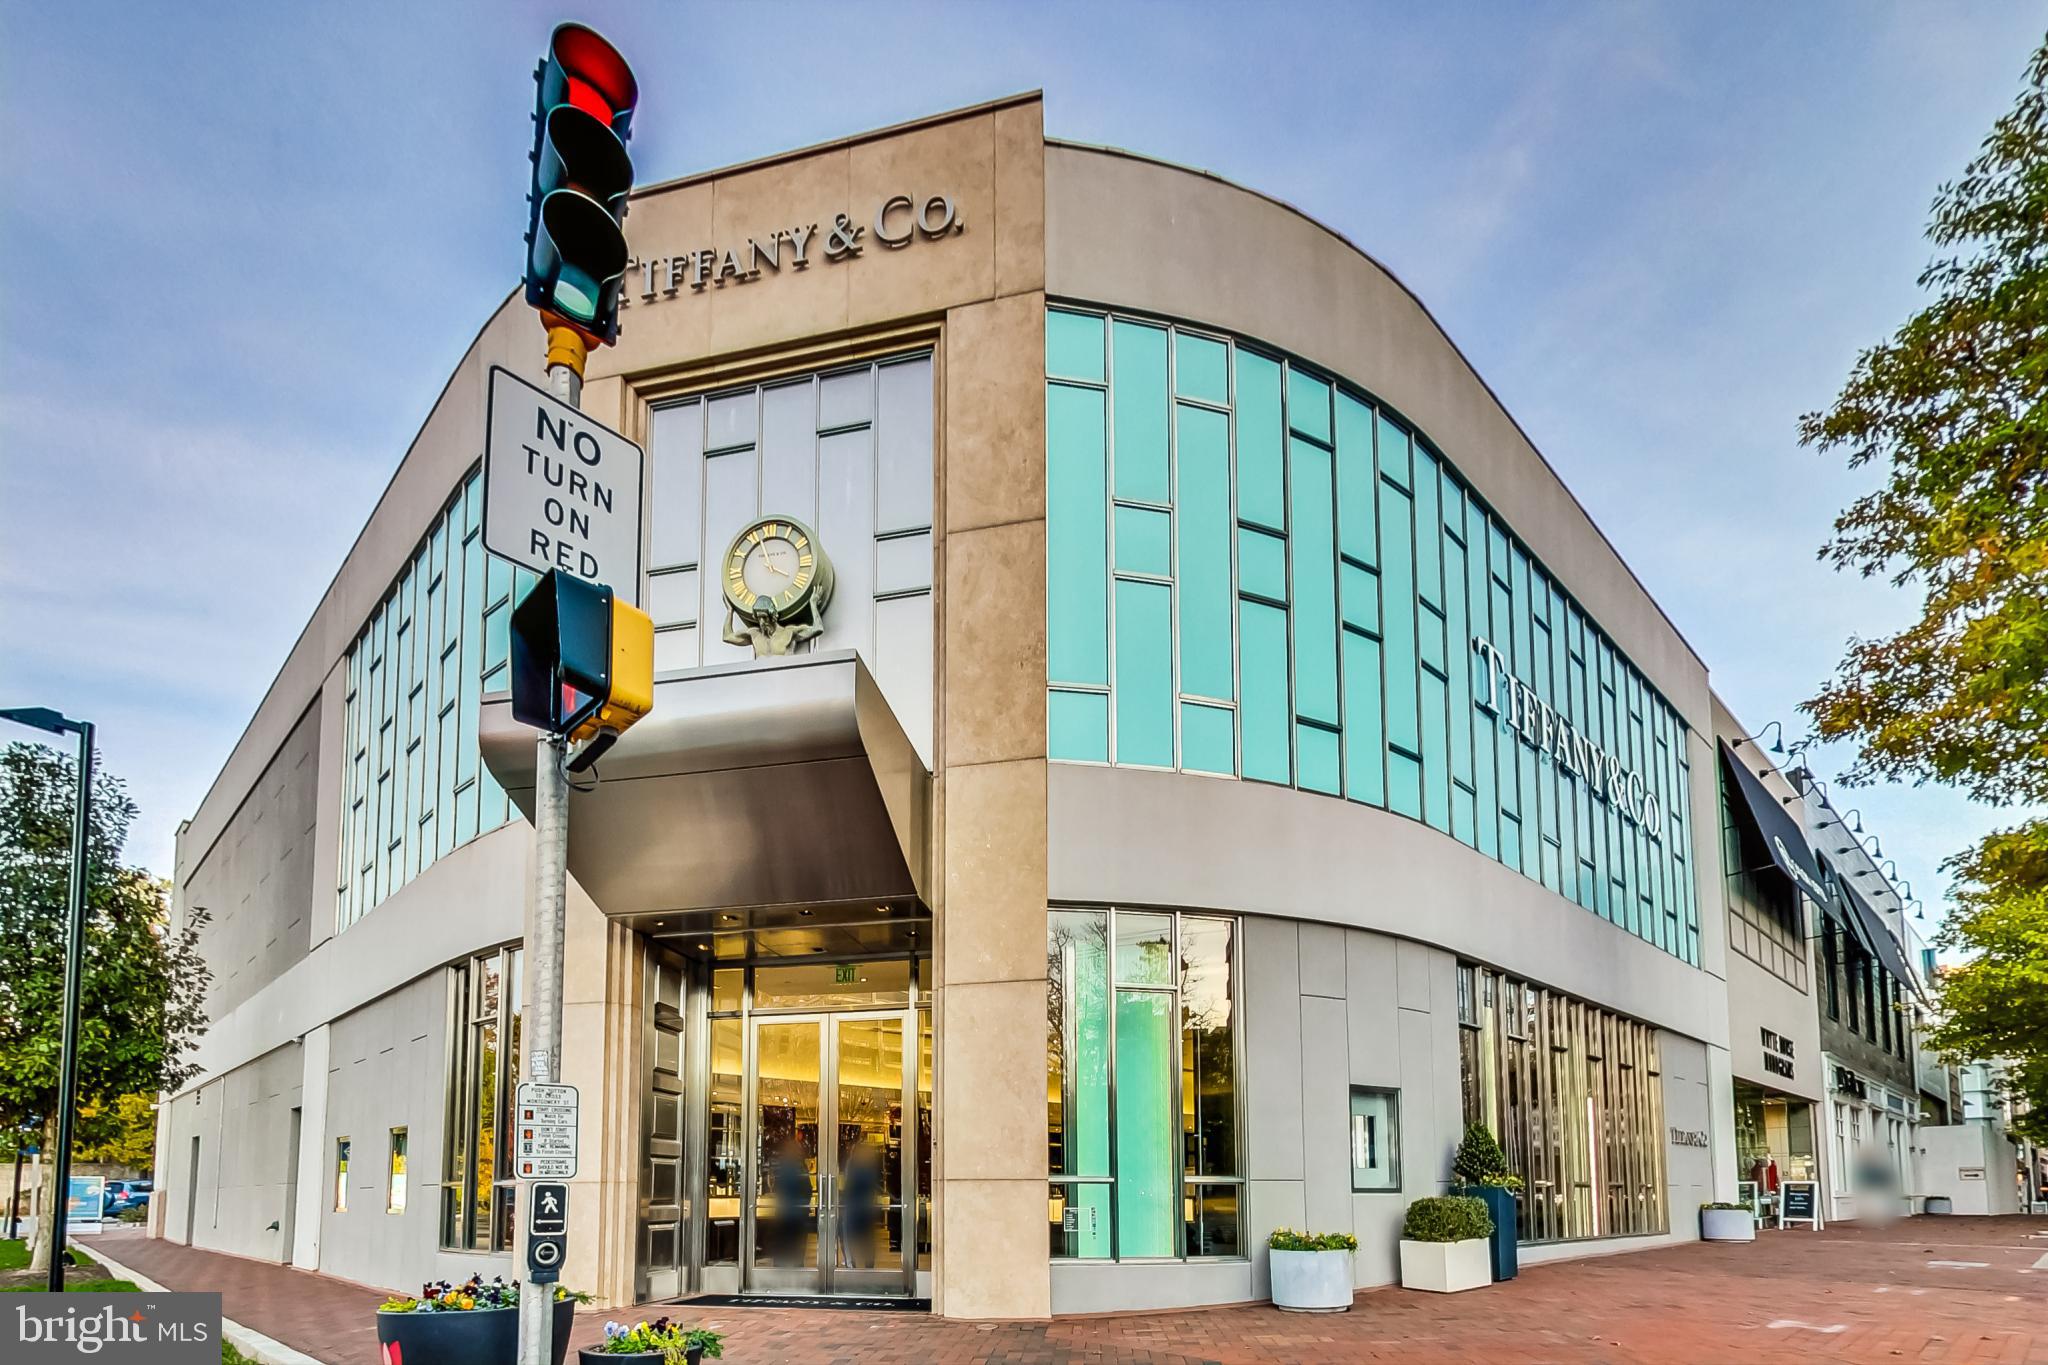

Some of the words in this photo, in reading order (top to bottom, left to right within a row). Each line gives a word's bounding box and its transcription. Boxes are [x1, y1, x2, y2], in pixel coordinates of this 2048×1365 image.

[824, 212, 865, 264] &
[536, 406, 602, 467] NO
[522, 444, 613, 514] TURN
[544, 497, 589, 540] ON
[530, 528, 598, 579] RED
[1473, 636, 1606, 798] TIFFANY
[836, 967, 856, 983] EXIT
